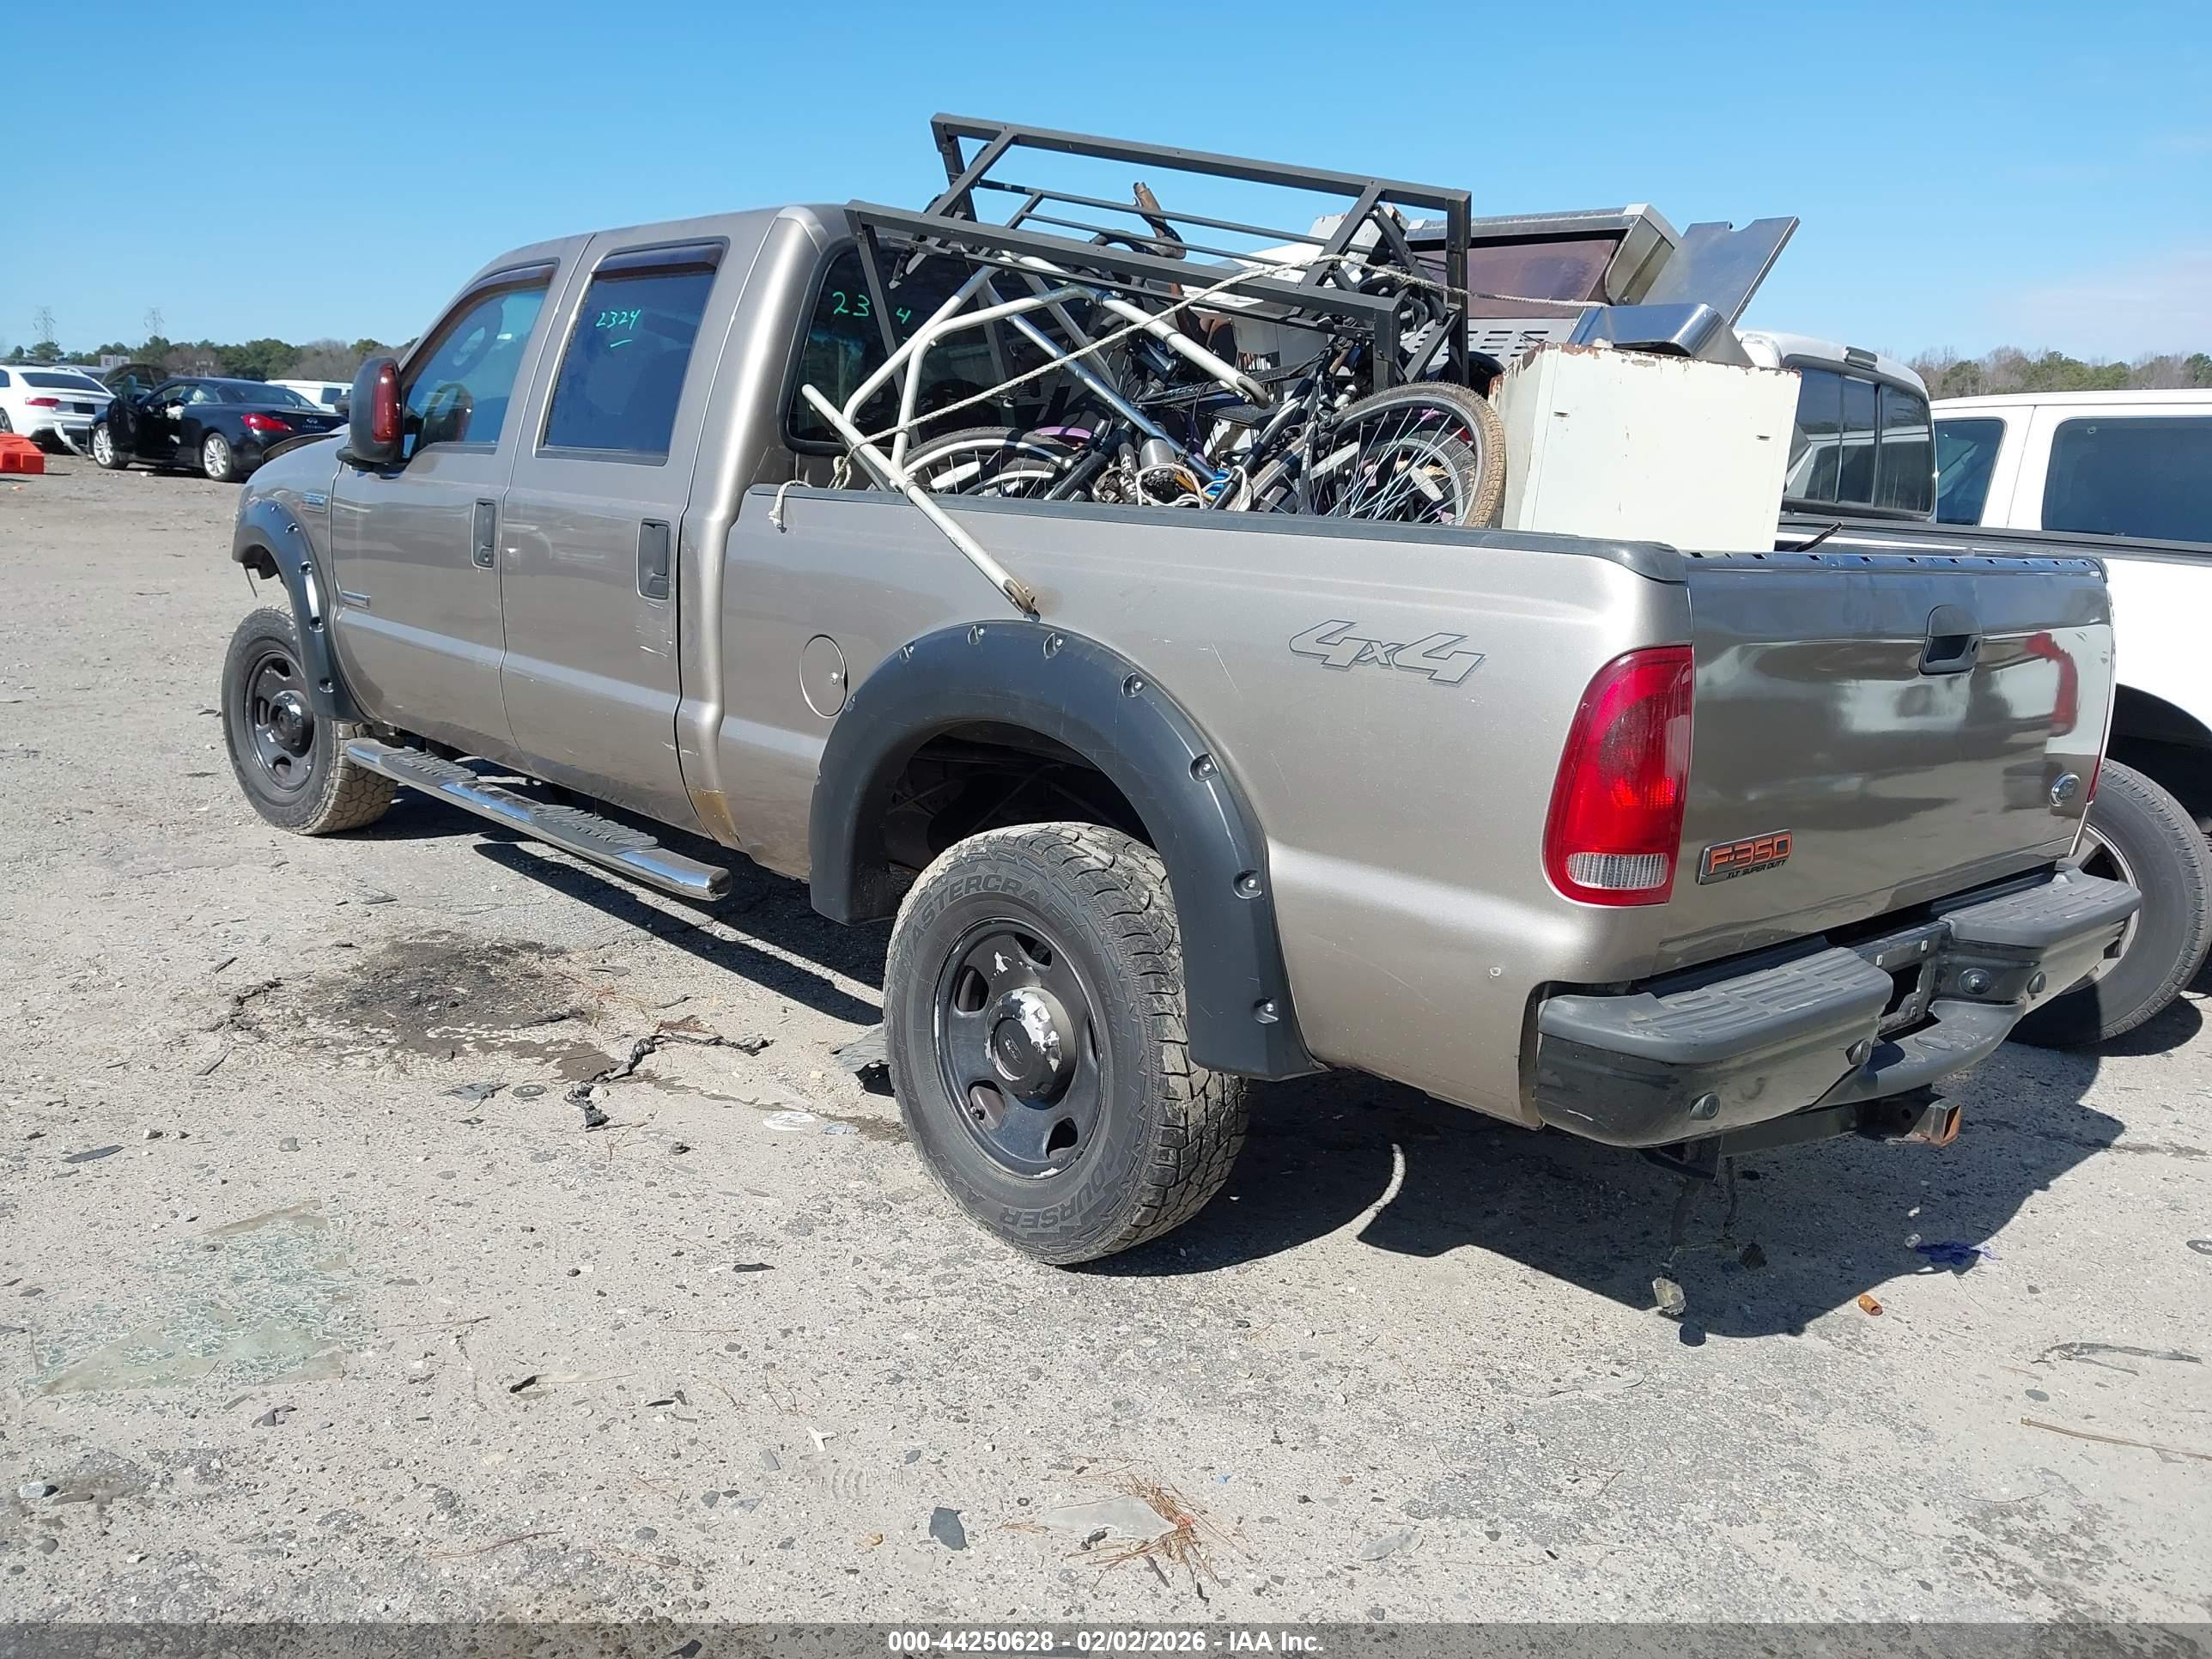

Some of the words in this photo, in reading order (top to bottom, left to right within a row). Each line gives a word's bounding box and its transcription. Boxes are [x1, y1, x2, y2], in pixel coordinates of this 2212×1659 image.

[595, 308, 641, 331] 2324
[832, 291, 912, 325] 234
[1726, 870, 1741, 880] XLT
[1741, 864, 1767, 876] SUPER
[1766, 859, 1786, 870] DUTY
